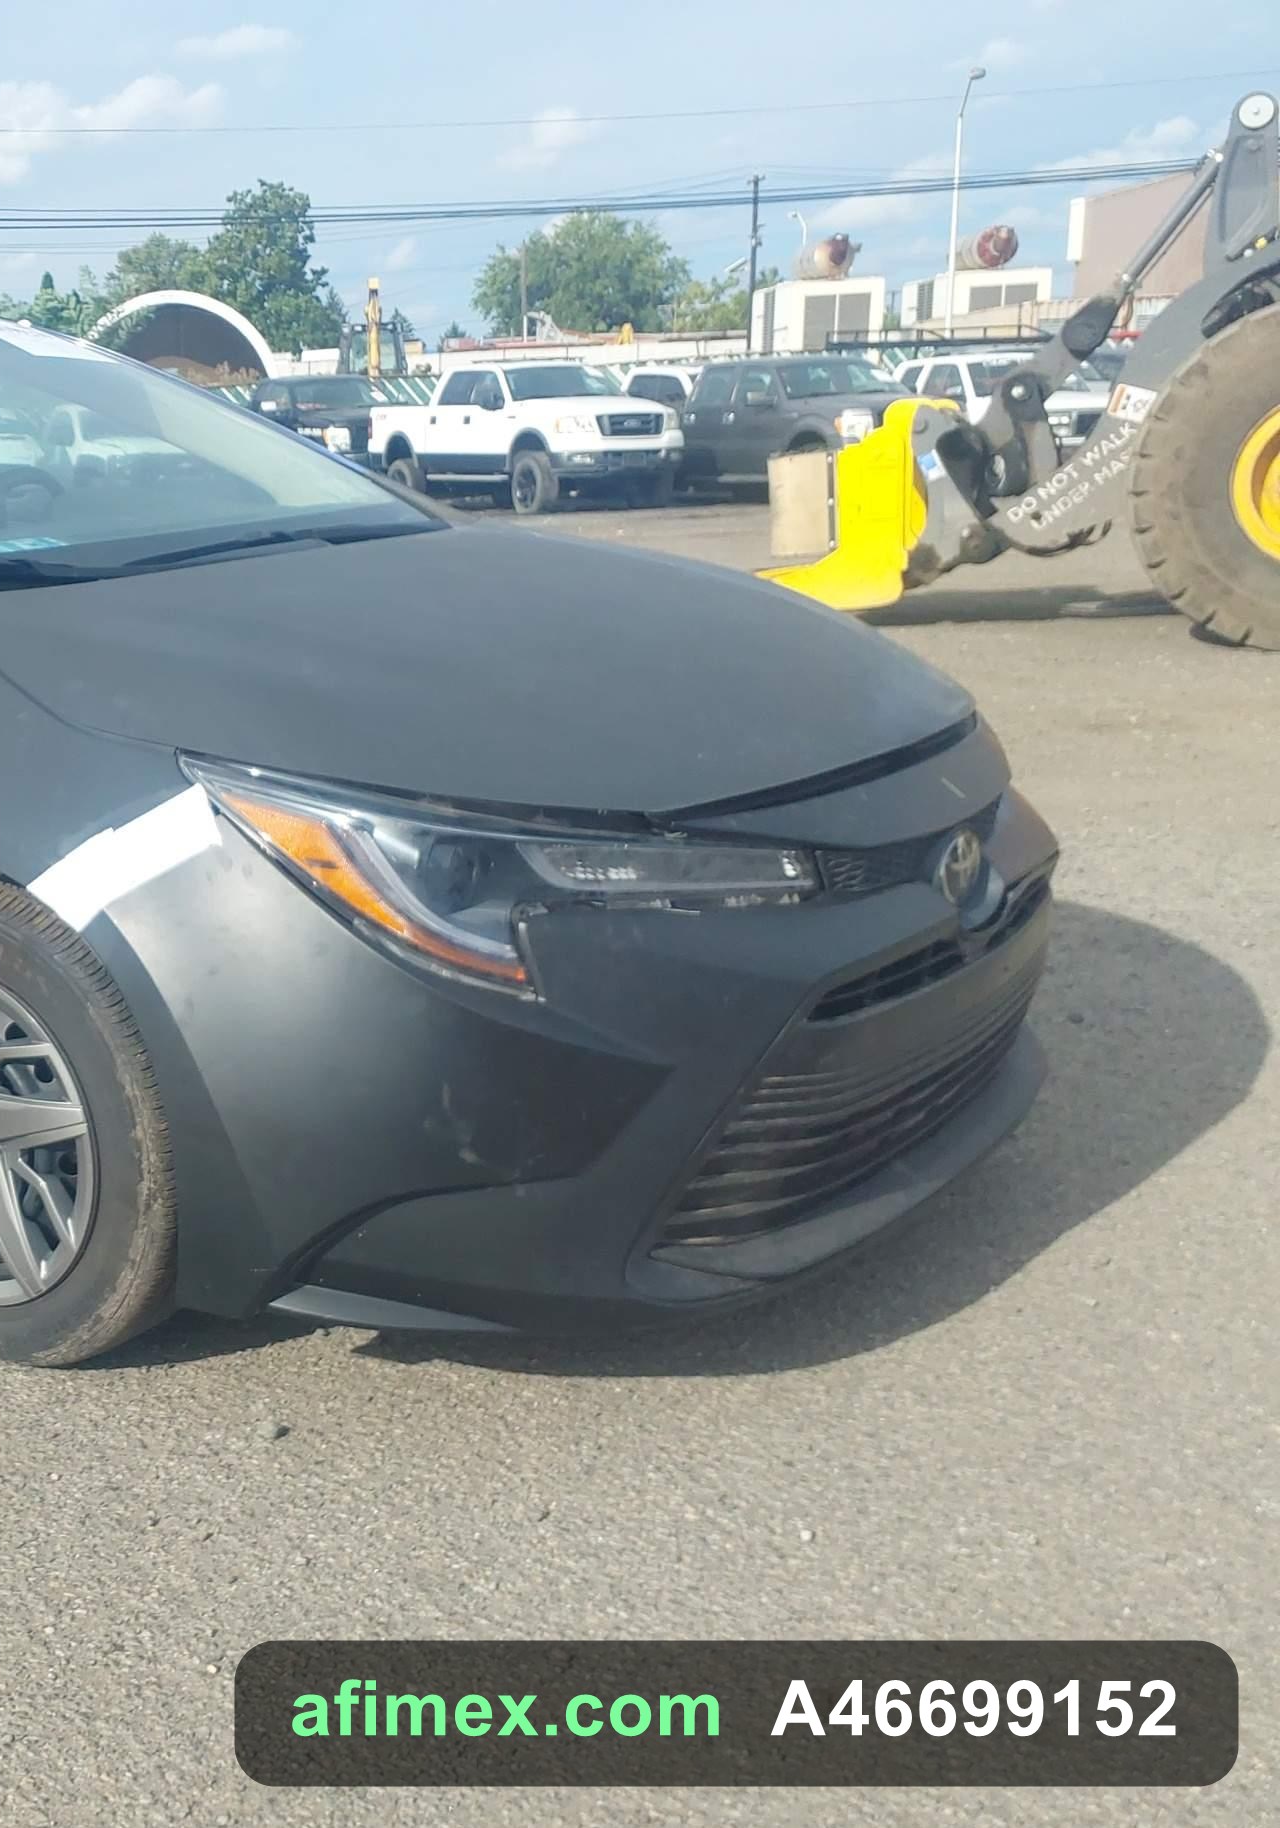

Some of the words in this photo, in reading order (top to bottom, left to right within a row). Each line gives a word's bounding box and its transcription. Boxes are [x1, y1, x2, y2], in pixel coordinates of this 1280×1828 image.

[1006, 496, 1037, 523] DO
[1037, 463, 1079, 500] NOT
[1081, 422, 1137, 466] WALK
[1030, 481, 1092, 529] UNDER
